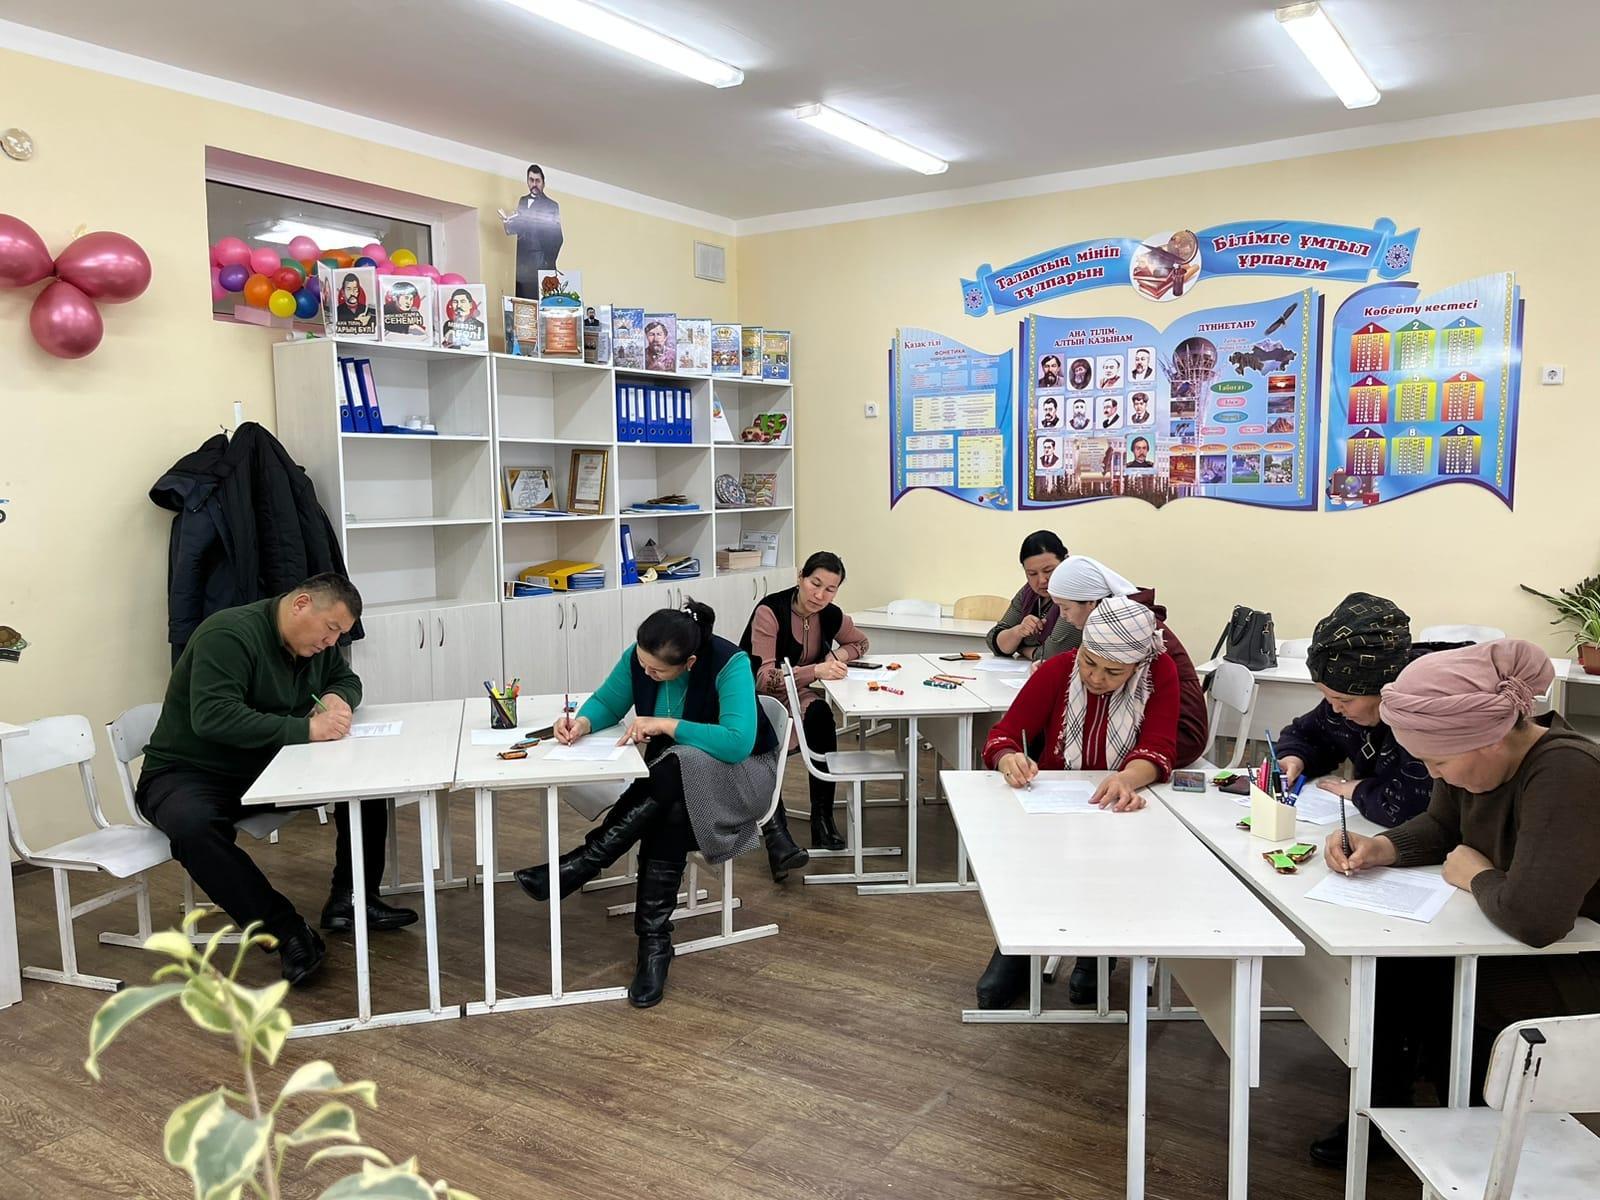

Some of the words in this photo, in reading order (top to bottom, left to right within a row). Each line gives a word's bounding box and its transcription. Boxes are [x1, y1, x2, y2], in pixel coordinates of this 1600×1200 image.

[1213, 232, 1290, 251] Білімге
[1301, 235, 1371, 255] ұмтыл
[1238, 255, 1327, 271] ұрпағым
[996, 256, 1070, 290] Талаптың
[1077, 246, 1120, 262] мініп
[1015, 267, 1104, 299] тұлпарын
[1364, 305, 1422, 316] Көбейту
[1425, 299, 1478, 312] кестесі
[1459, 319, 1466, 327] 3
[1069, 330, 1086, 338] АНА
[1055, 338, 1085, 347] АЛТЫН
[1366, 377, 1373, 385] 4
[1413, 374, 1420, 382] 5
[1459, 373, 1467, 381] 6
[1364, 429, 1370, 438] 7
[1409, 428, 1416, 436] 8
[1457, 426, 1465, 435] 9
